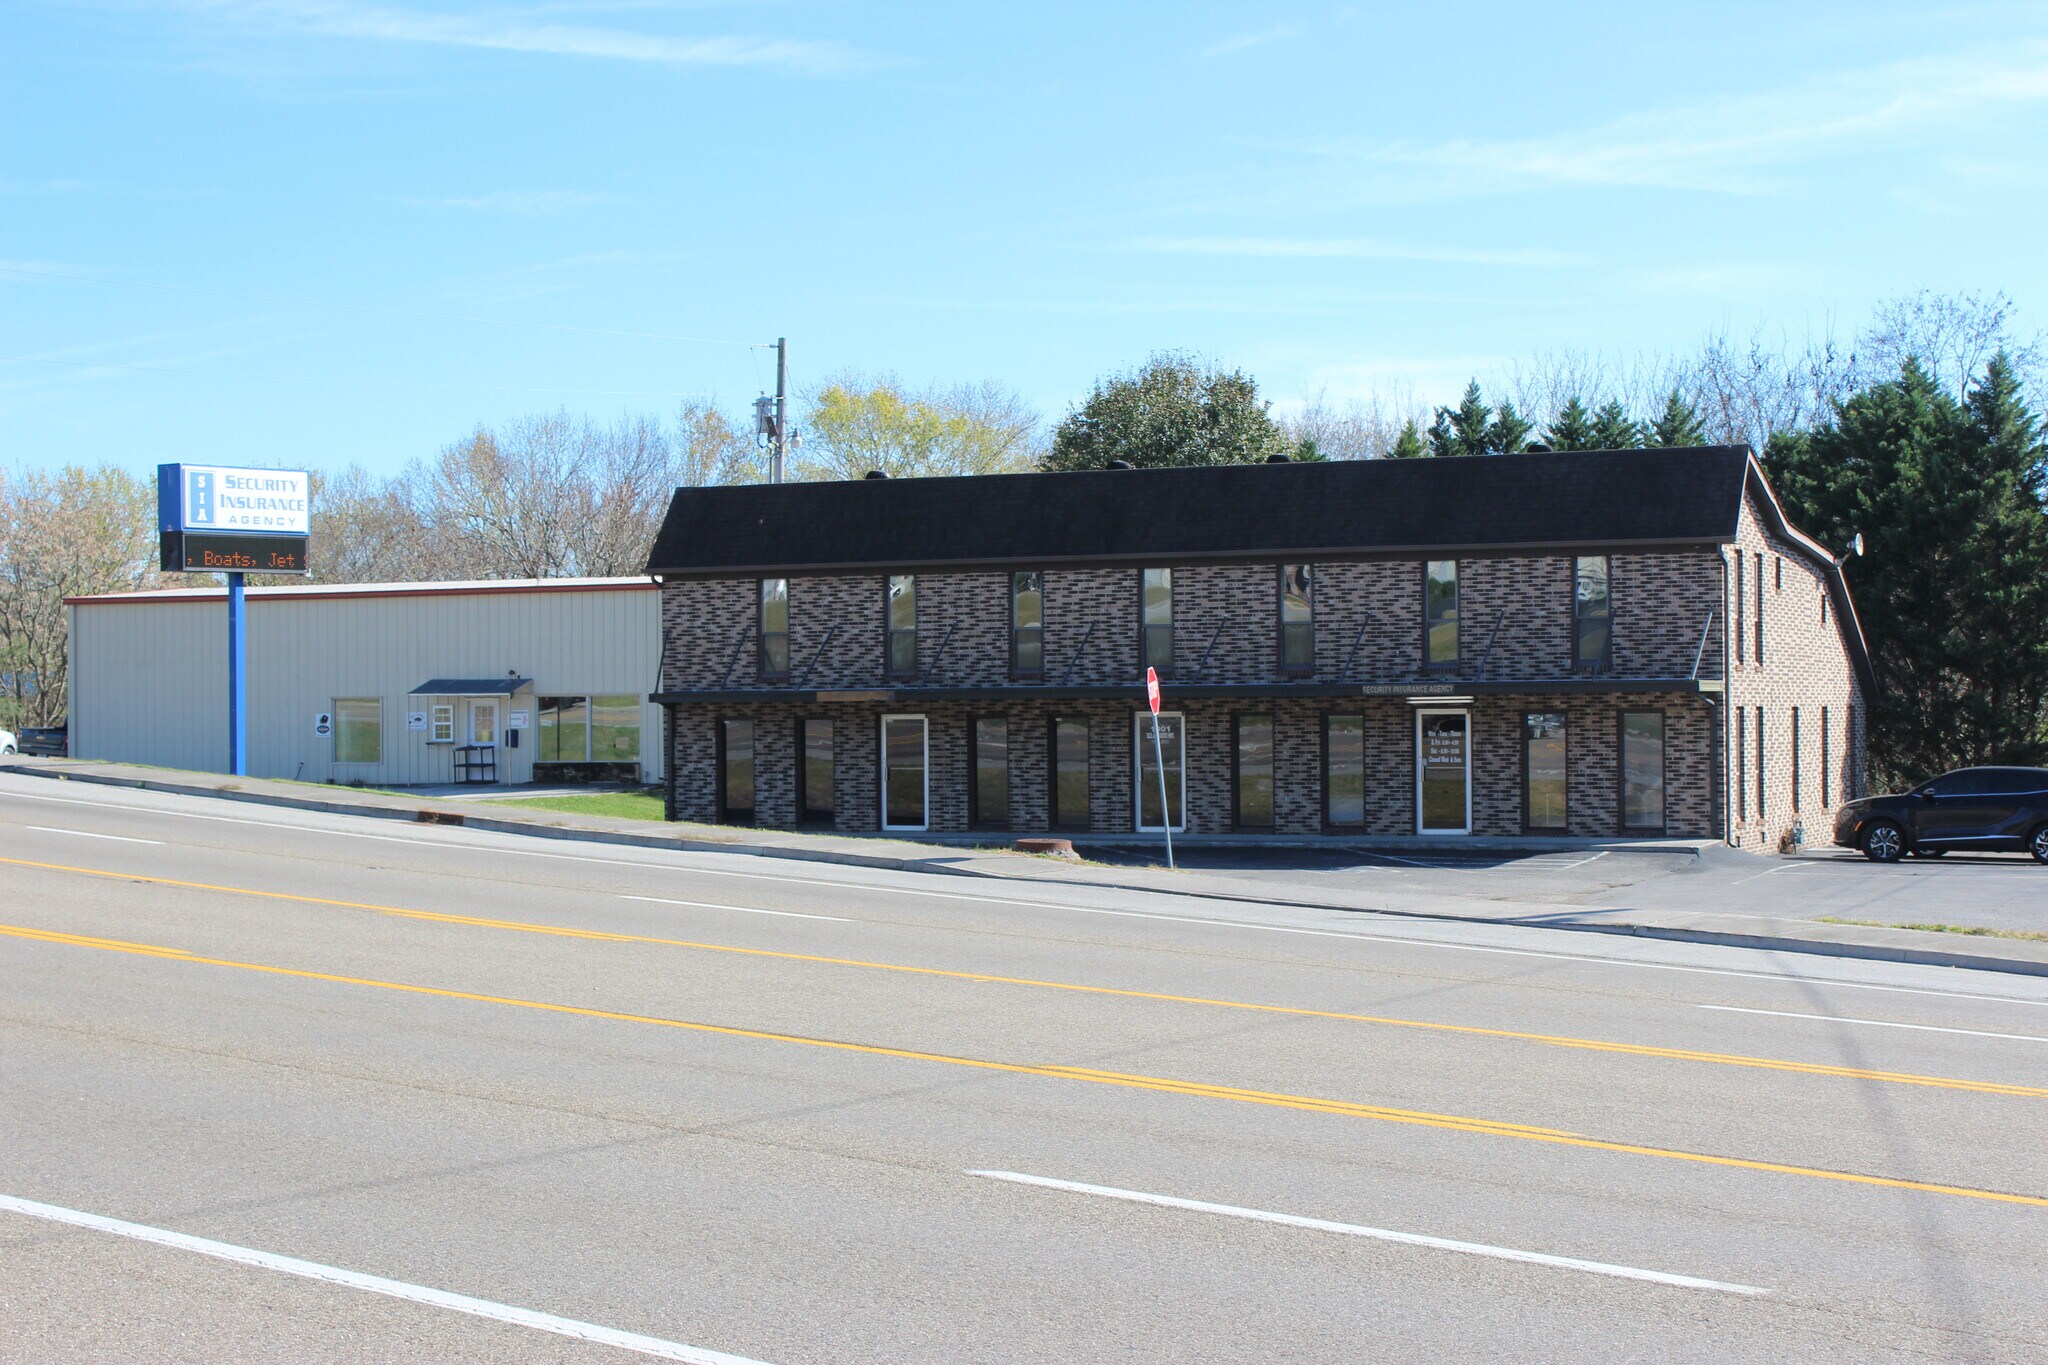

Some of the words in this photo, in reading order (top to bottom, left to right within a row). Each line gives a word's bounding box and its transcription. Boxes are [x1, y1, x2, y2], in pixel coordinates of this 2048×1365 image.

[225, 475, 299, 492] SECURITY
[220, 494, 305, 511] INSURANCE
[229, 515, 296, 526] AGENCY
[204, 550, 257, 567] Boats,
[268, 552, 295, 568] Jet
[1362, 685, 1391, 694] SECURITY
[1393, 685, 1428, 694] INSURANCE
[1428, 684, 1454, 693] AGENCY
